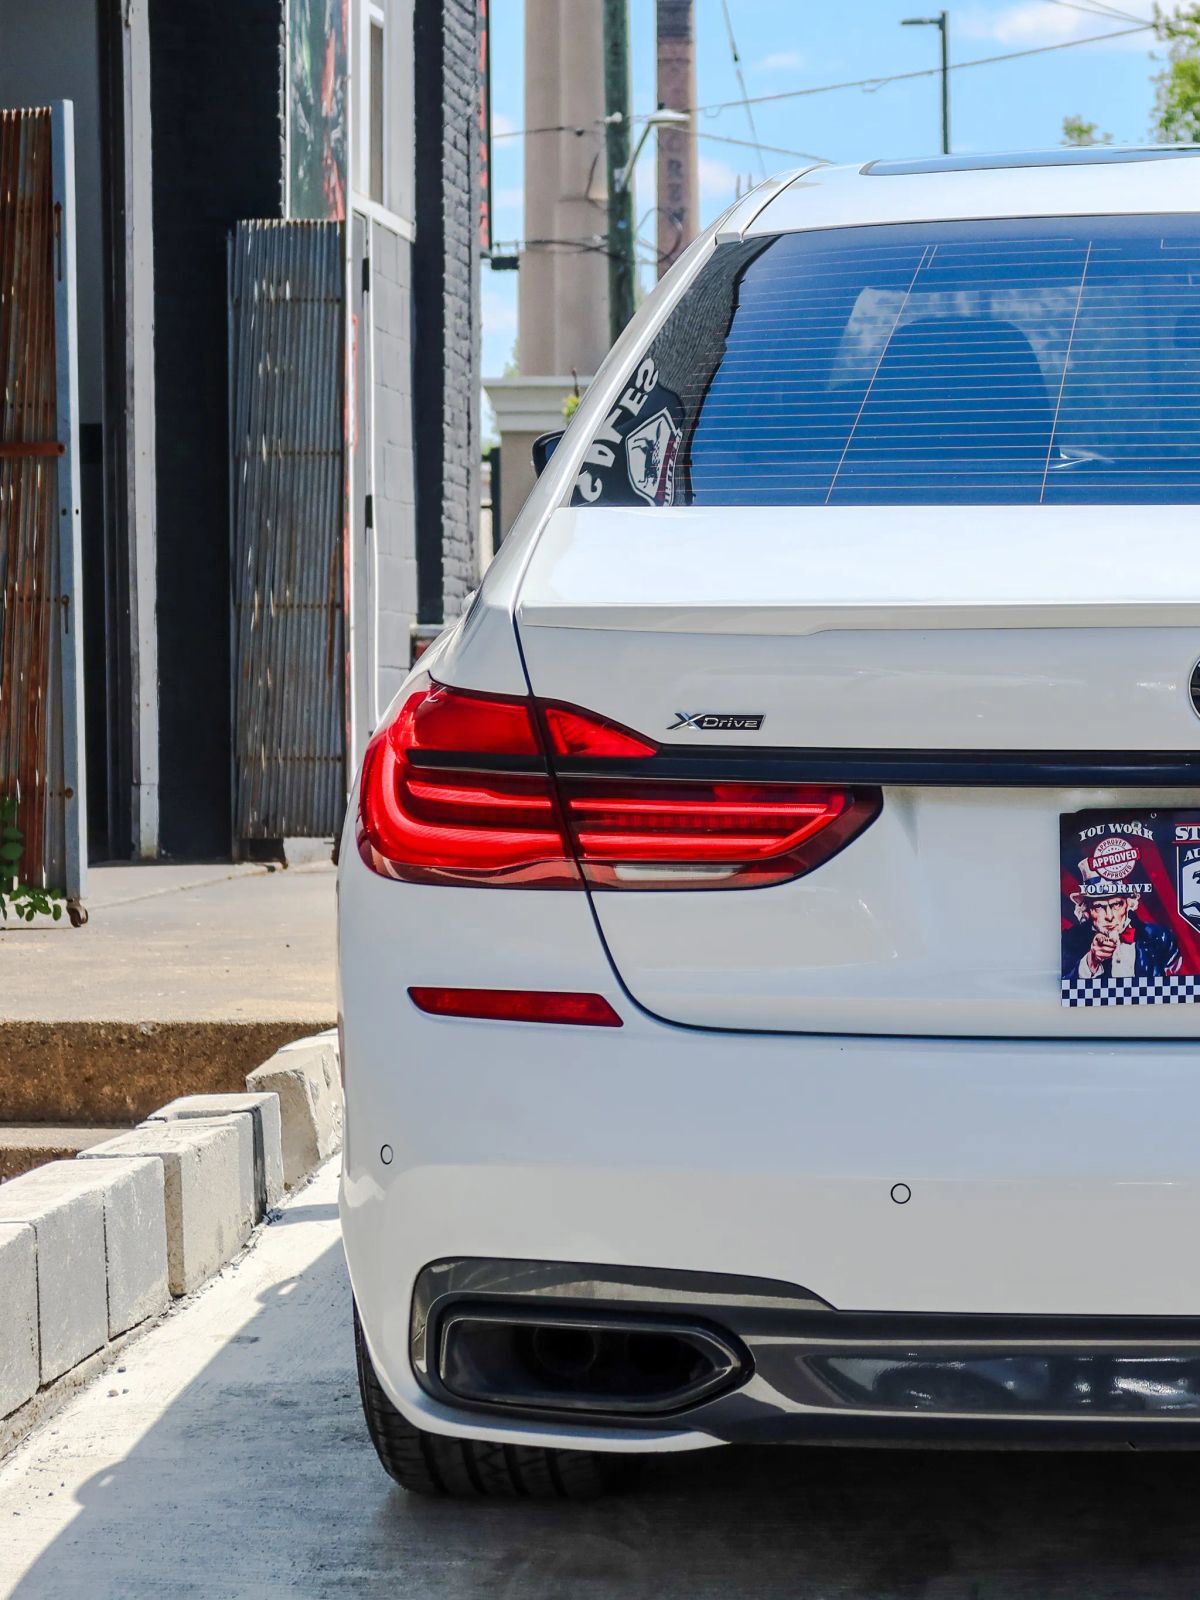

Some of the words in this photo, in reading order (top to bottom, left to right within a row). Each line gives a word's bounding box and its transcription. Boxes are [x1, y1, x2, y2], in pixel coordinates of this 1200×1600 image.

[1078, 823, 1105, 841] YOU
[1108, 823, 1154, 841] WORK
[1093, 849, 1138, 869] APPROVED
[1078, 884, 1105, 894] YOU
[1108, 883, 1152, 893] DRIVE
